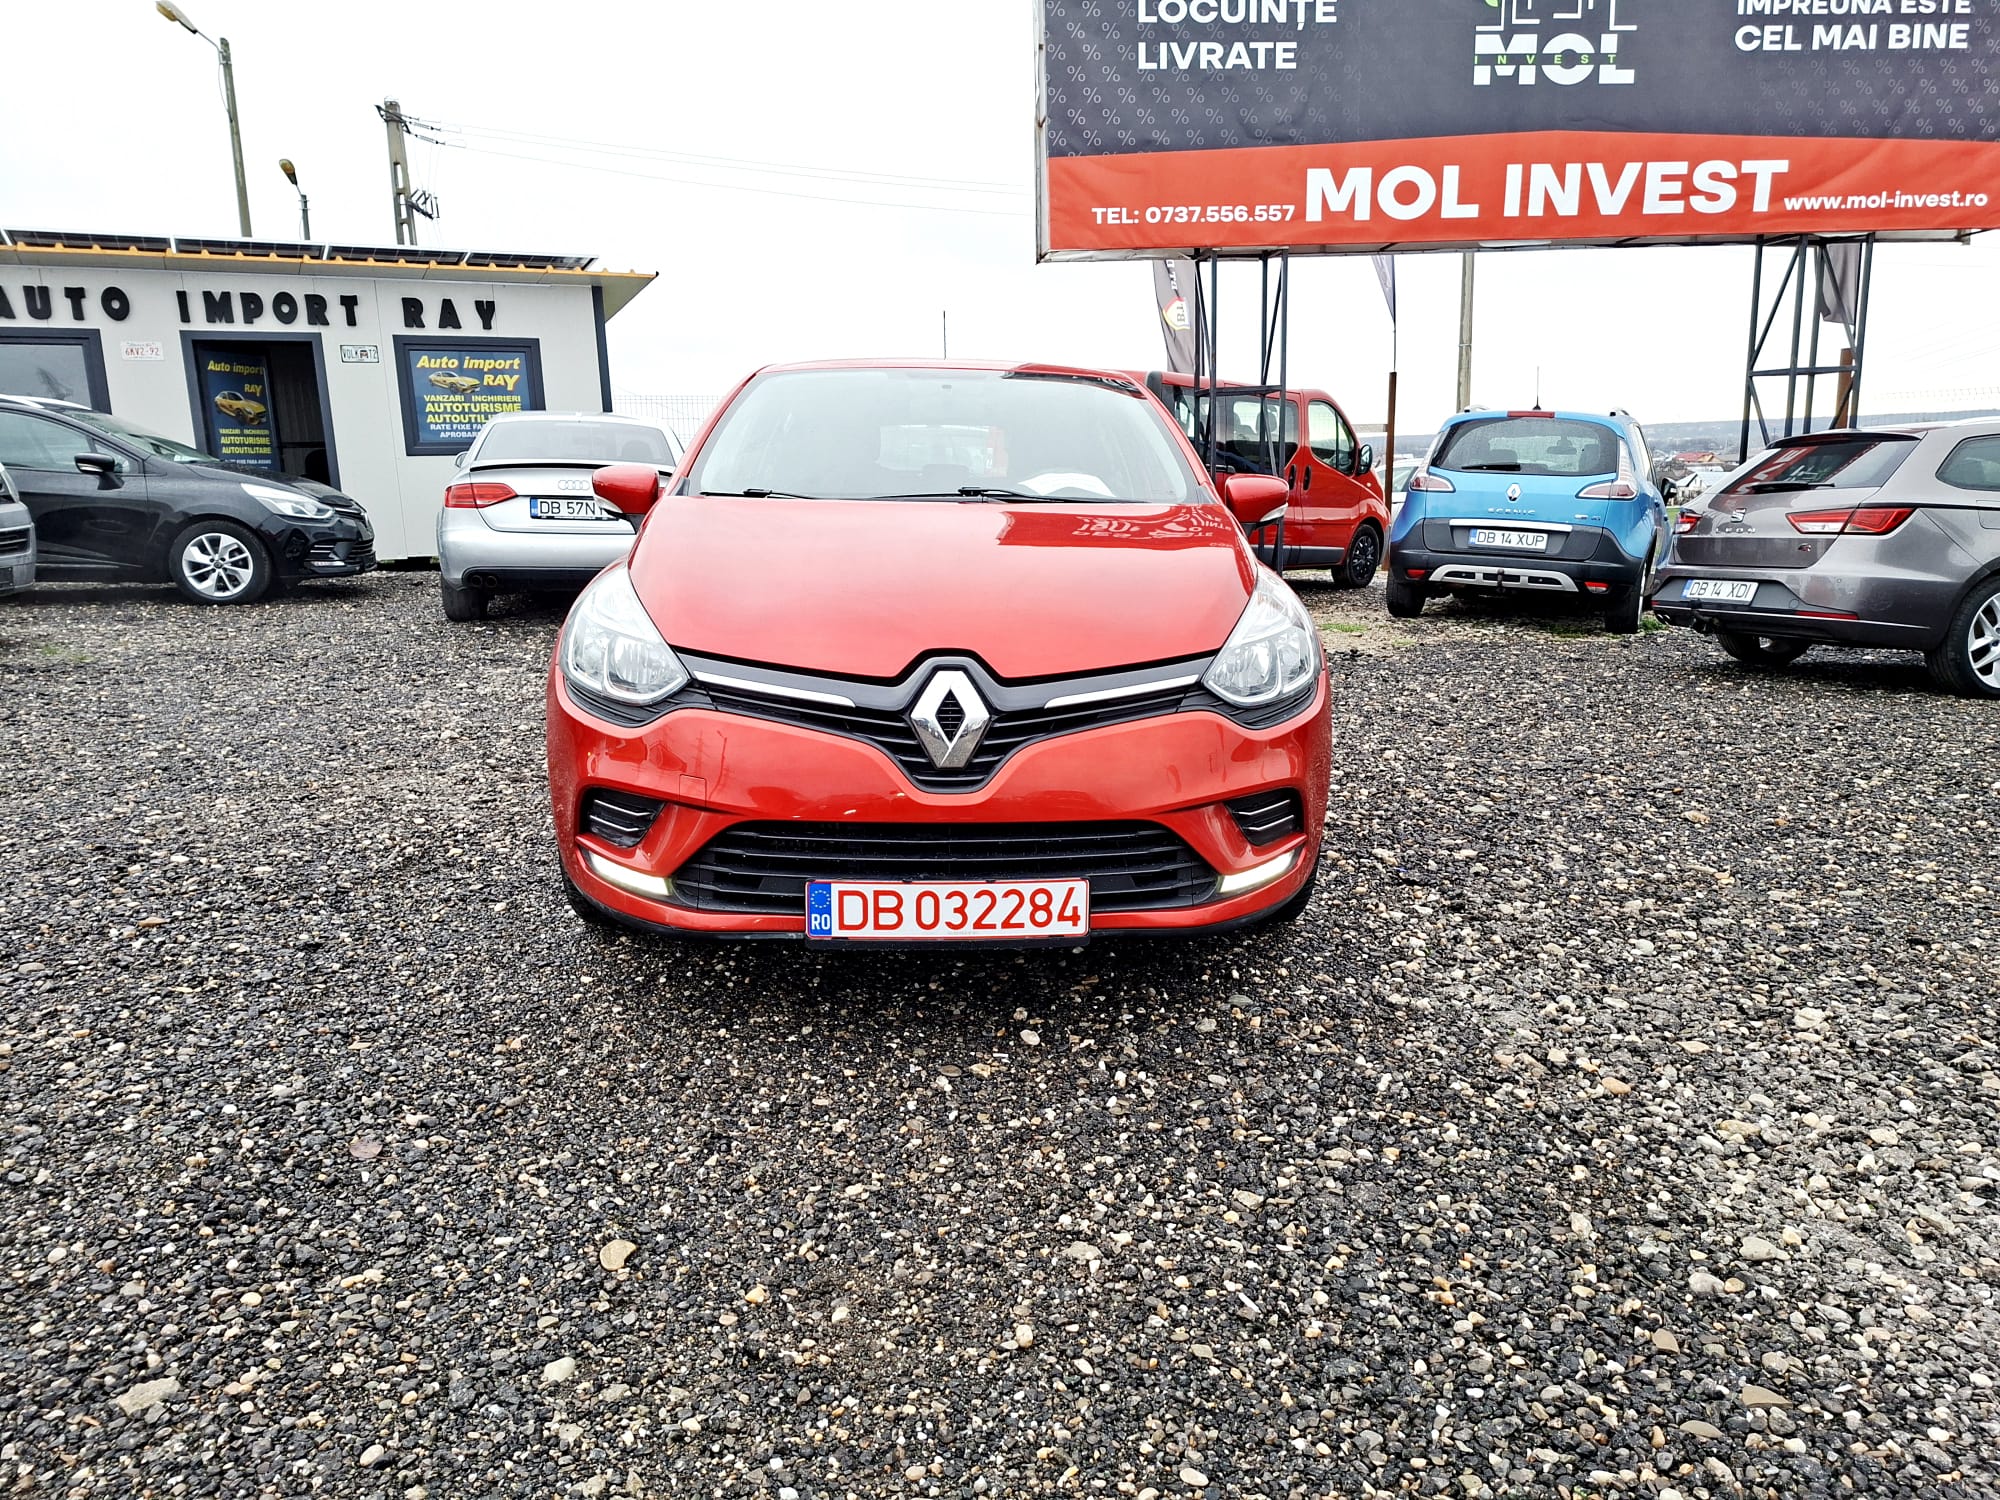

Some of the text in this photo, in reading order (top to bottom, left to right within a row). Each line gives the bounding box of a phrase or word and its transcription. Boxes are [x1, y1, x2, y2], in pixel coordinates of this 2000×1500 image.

[1137, 0, 1337, 30] LOCUINȚE
[1901, 0, 1971, 14] ESTE
[1734, 23, 1969, 51] CEL MAI BINE
[1137, 41, 1297, 70] LIVRATE
[1473, 33, 1635, 85] MOL
[1474, 54, 1616, 64] INVEST
[1305, 159, 1789, 222] MOL INVEST
[1784, 190, 1988, 210] www.mol-invest.ro
[1092, 204, 1295, 225] TEL: 0737.556.557
[176, 290, 359, 327] IMPORT
[401, 297, 496, 329] RAY
[208, 360, 231, 371] Auto
[416, 355, 520, 372] Auto import
[244, 383, 263, 397] RAY
[483, 374, 519, 391] RAY
[472, 395, 520, 403] INCHIRIERI
[425, 403, 522, 413] AUTOTURISME
[221, 436, 271, 445] AUTOTURISME
[540, 500, 561, 515] DB
[1477, 531, 1496, 544] DB
[1501, 533, 1512, 544] 14
[1516, 535, 1545, 547] XUP
[1689, 582, 1752, 599] DB 14 XDI
[811, 886, 1081, 931] RO DB 032284
